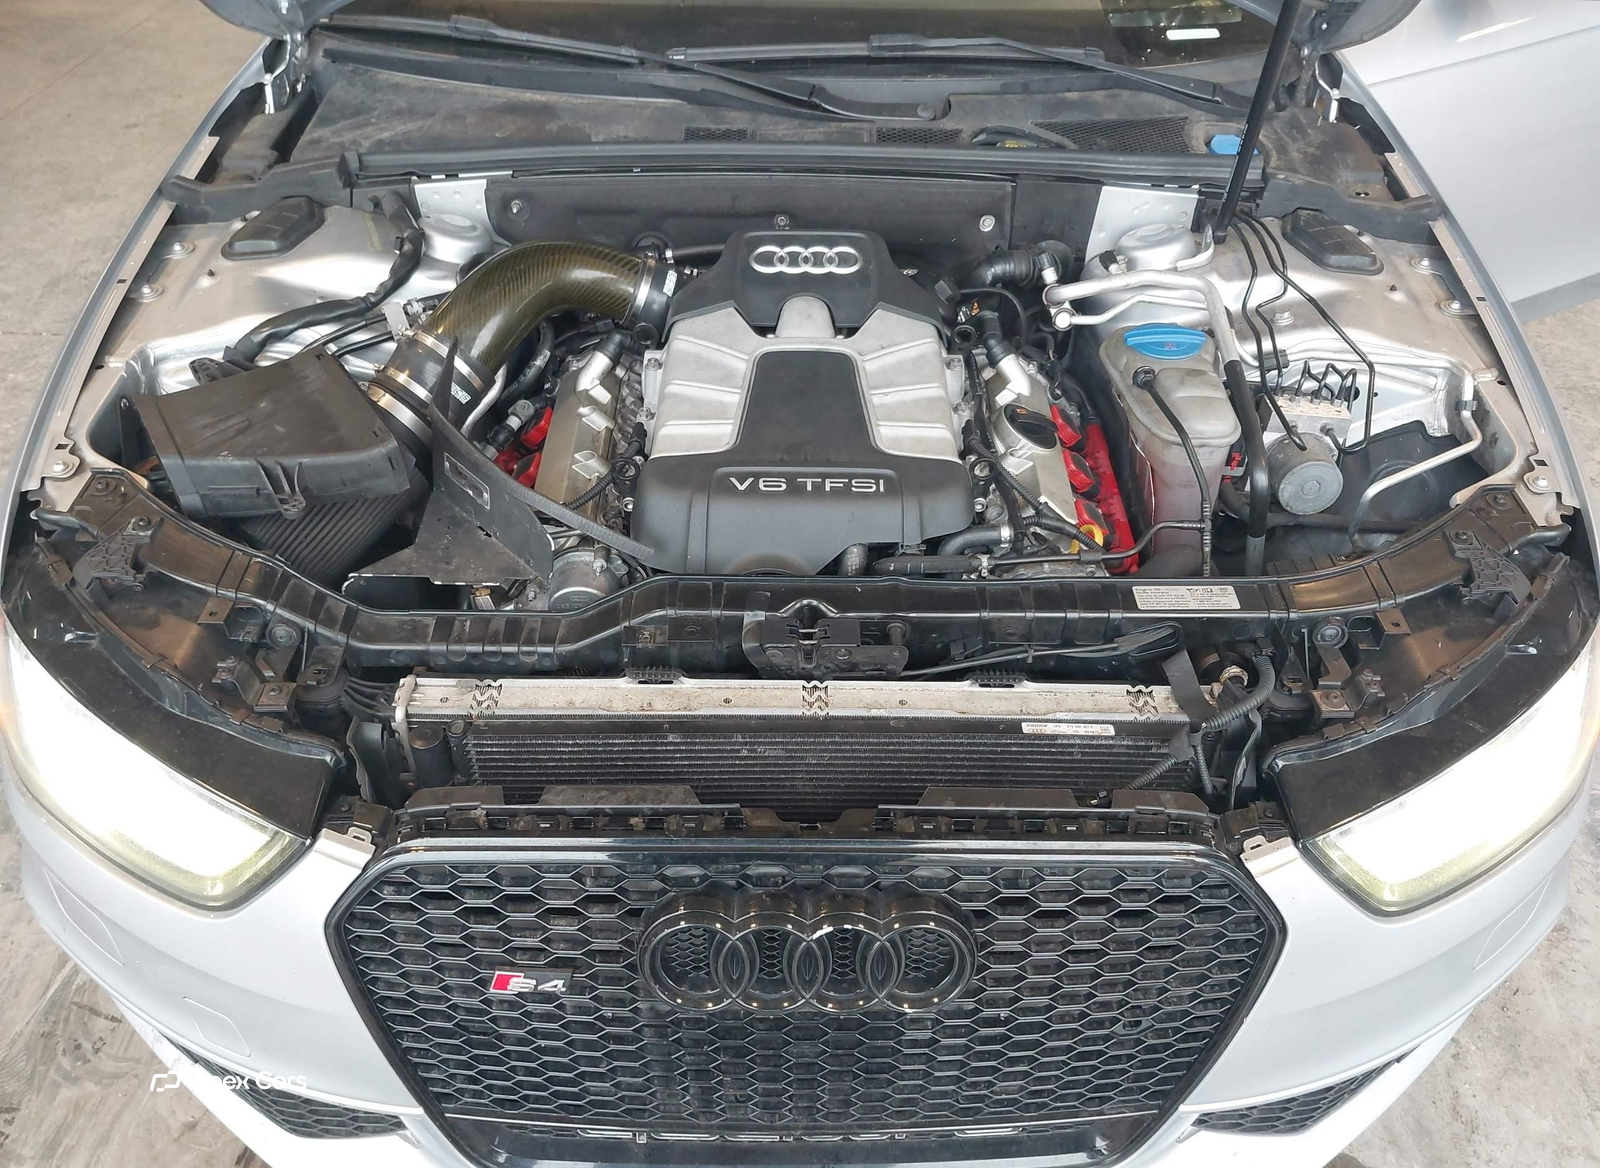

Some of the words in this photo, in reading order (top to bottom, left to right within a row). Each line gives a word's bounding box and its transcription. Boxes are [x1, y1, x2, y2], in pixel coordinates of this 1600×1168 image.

[729, 477, 788, 492] V6
[796, 478, 886, 493] TFSI
[507, 977, 567, 994] S4
